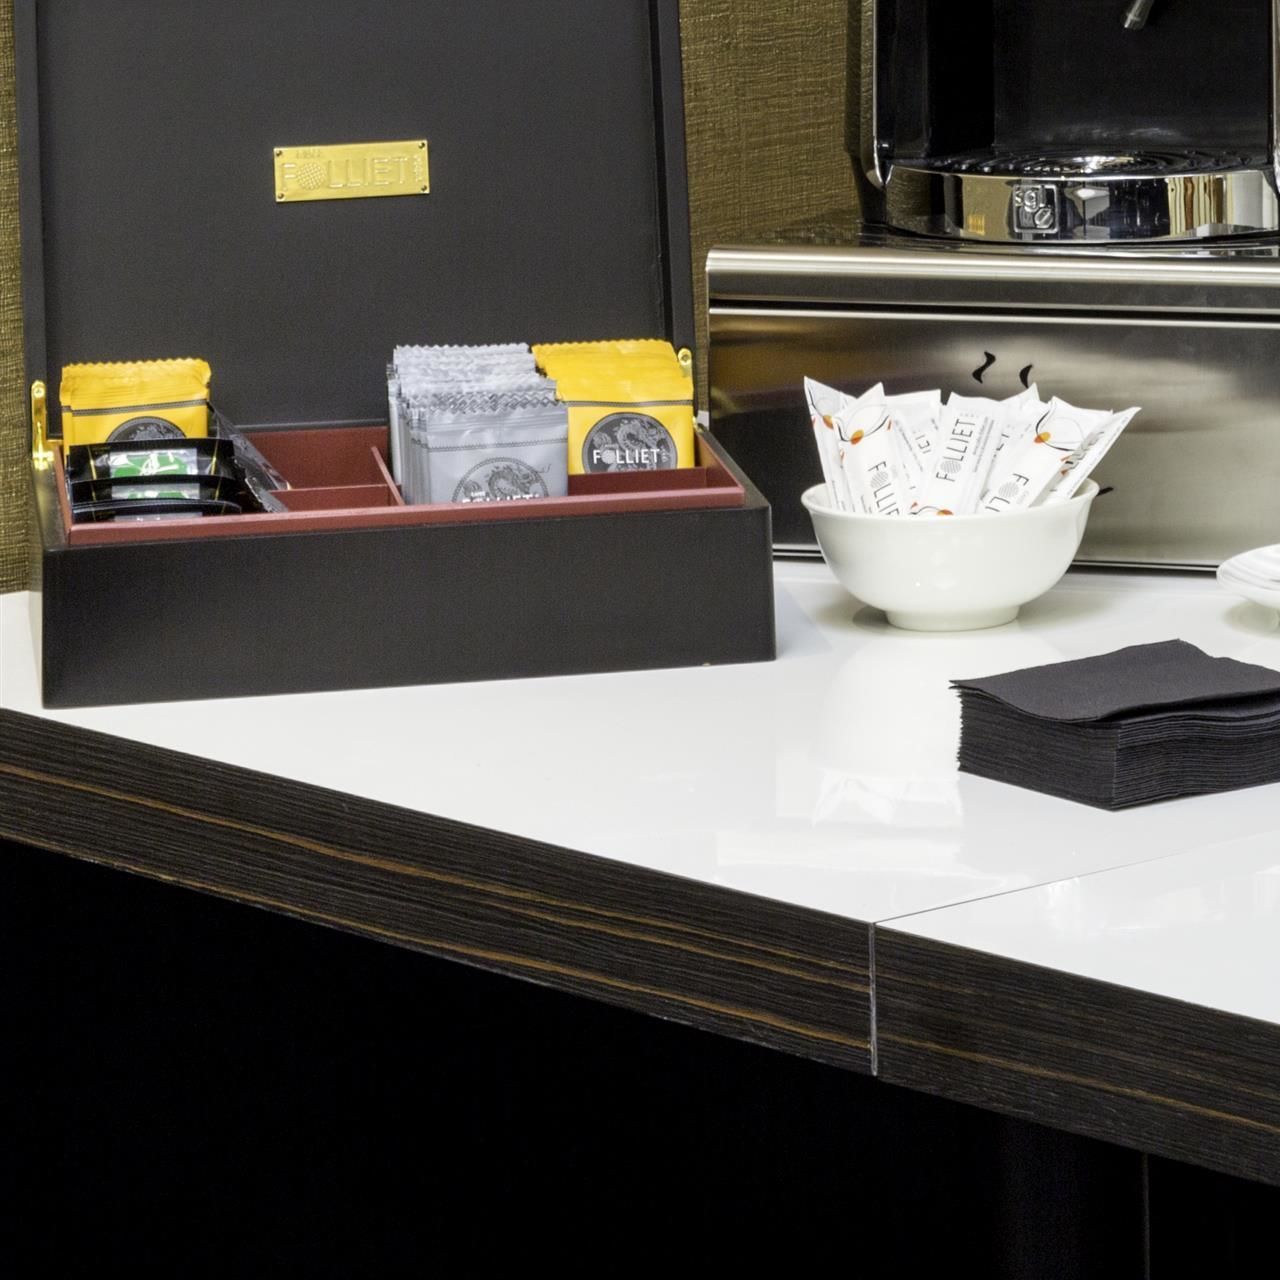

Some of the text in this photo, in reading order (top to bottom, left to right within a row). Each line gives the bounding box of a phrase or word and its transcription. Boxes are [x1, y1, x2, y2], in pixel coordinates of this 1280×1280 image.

[281, 156, 409, 192] FOLLIET
[592, 448, 661, 465] FOLLIET
[936, 418, 976, 482] FOLLIET
